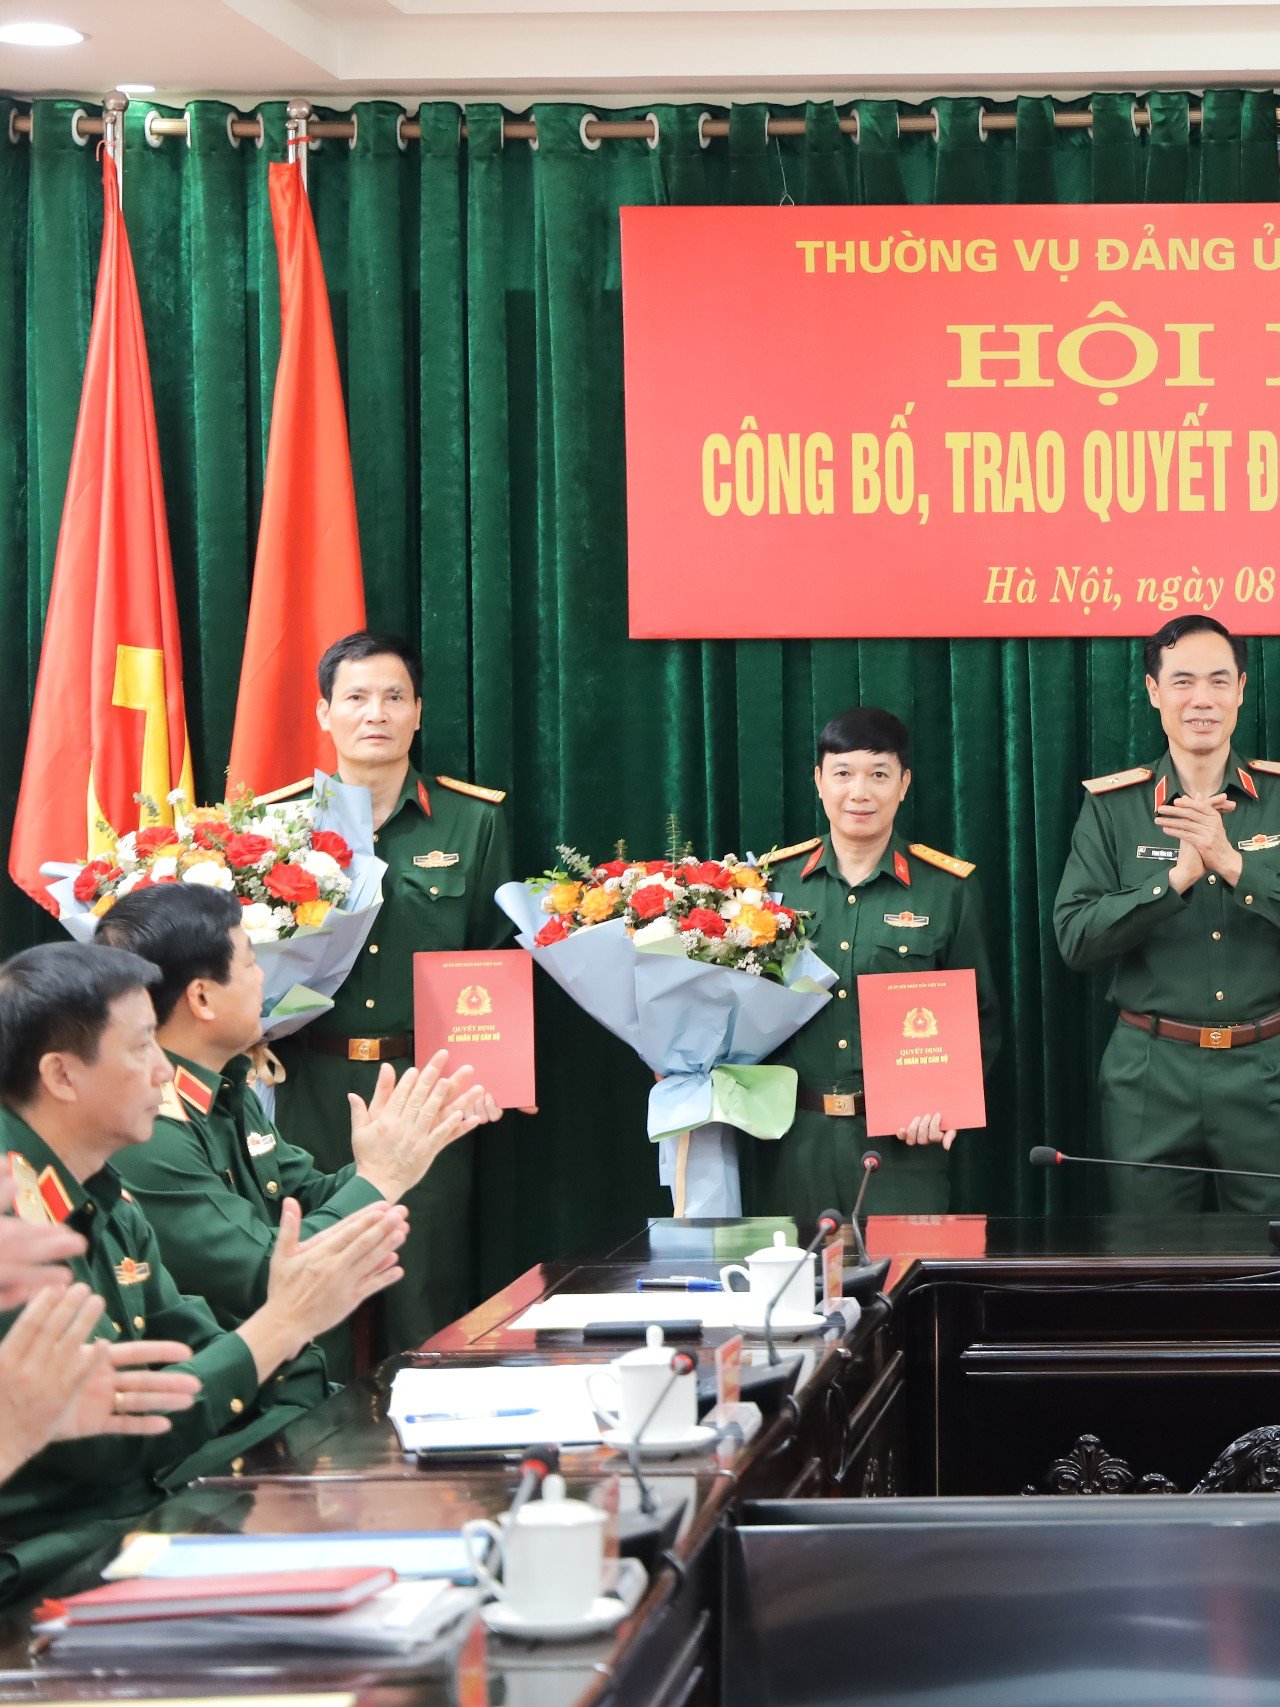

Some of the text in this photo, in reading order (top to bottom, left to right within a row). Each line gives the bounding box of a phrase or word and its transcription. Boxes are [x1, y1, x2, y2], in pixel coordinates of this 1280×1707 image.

[795, 231, 997, 274] THƯỜNG
[1012, 239, 1080, 283] VỤ
[1094, 224, 1236, 272] ĐẢNG
[946, 300, 1216, 406] HỘI
[701, 415, 835, 516] CÔNG
[851, 402, 930, 525] BỐ,
[945, 429, 1066, 514] TRAO
[1083, 402, 1233, 523] QUYẾT
[983, 566, 1038, 604] Hà
[1049, 565, 1123, 616] Nội,
[1136, 565, 1225, 612] ngày
[1234, 565, 1277, 603] 08
